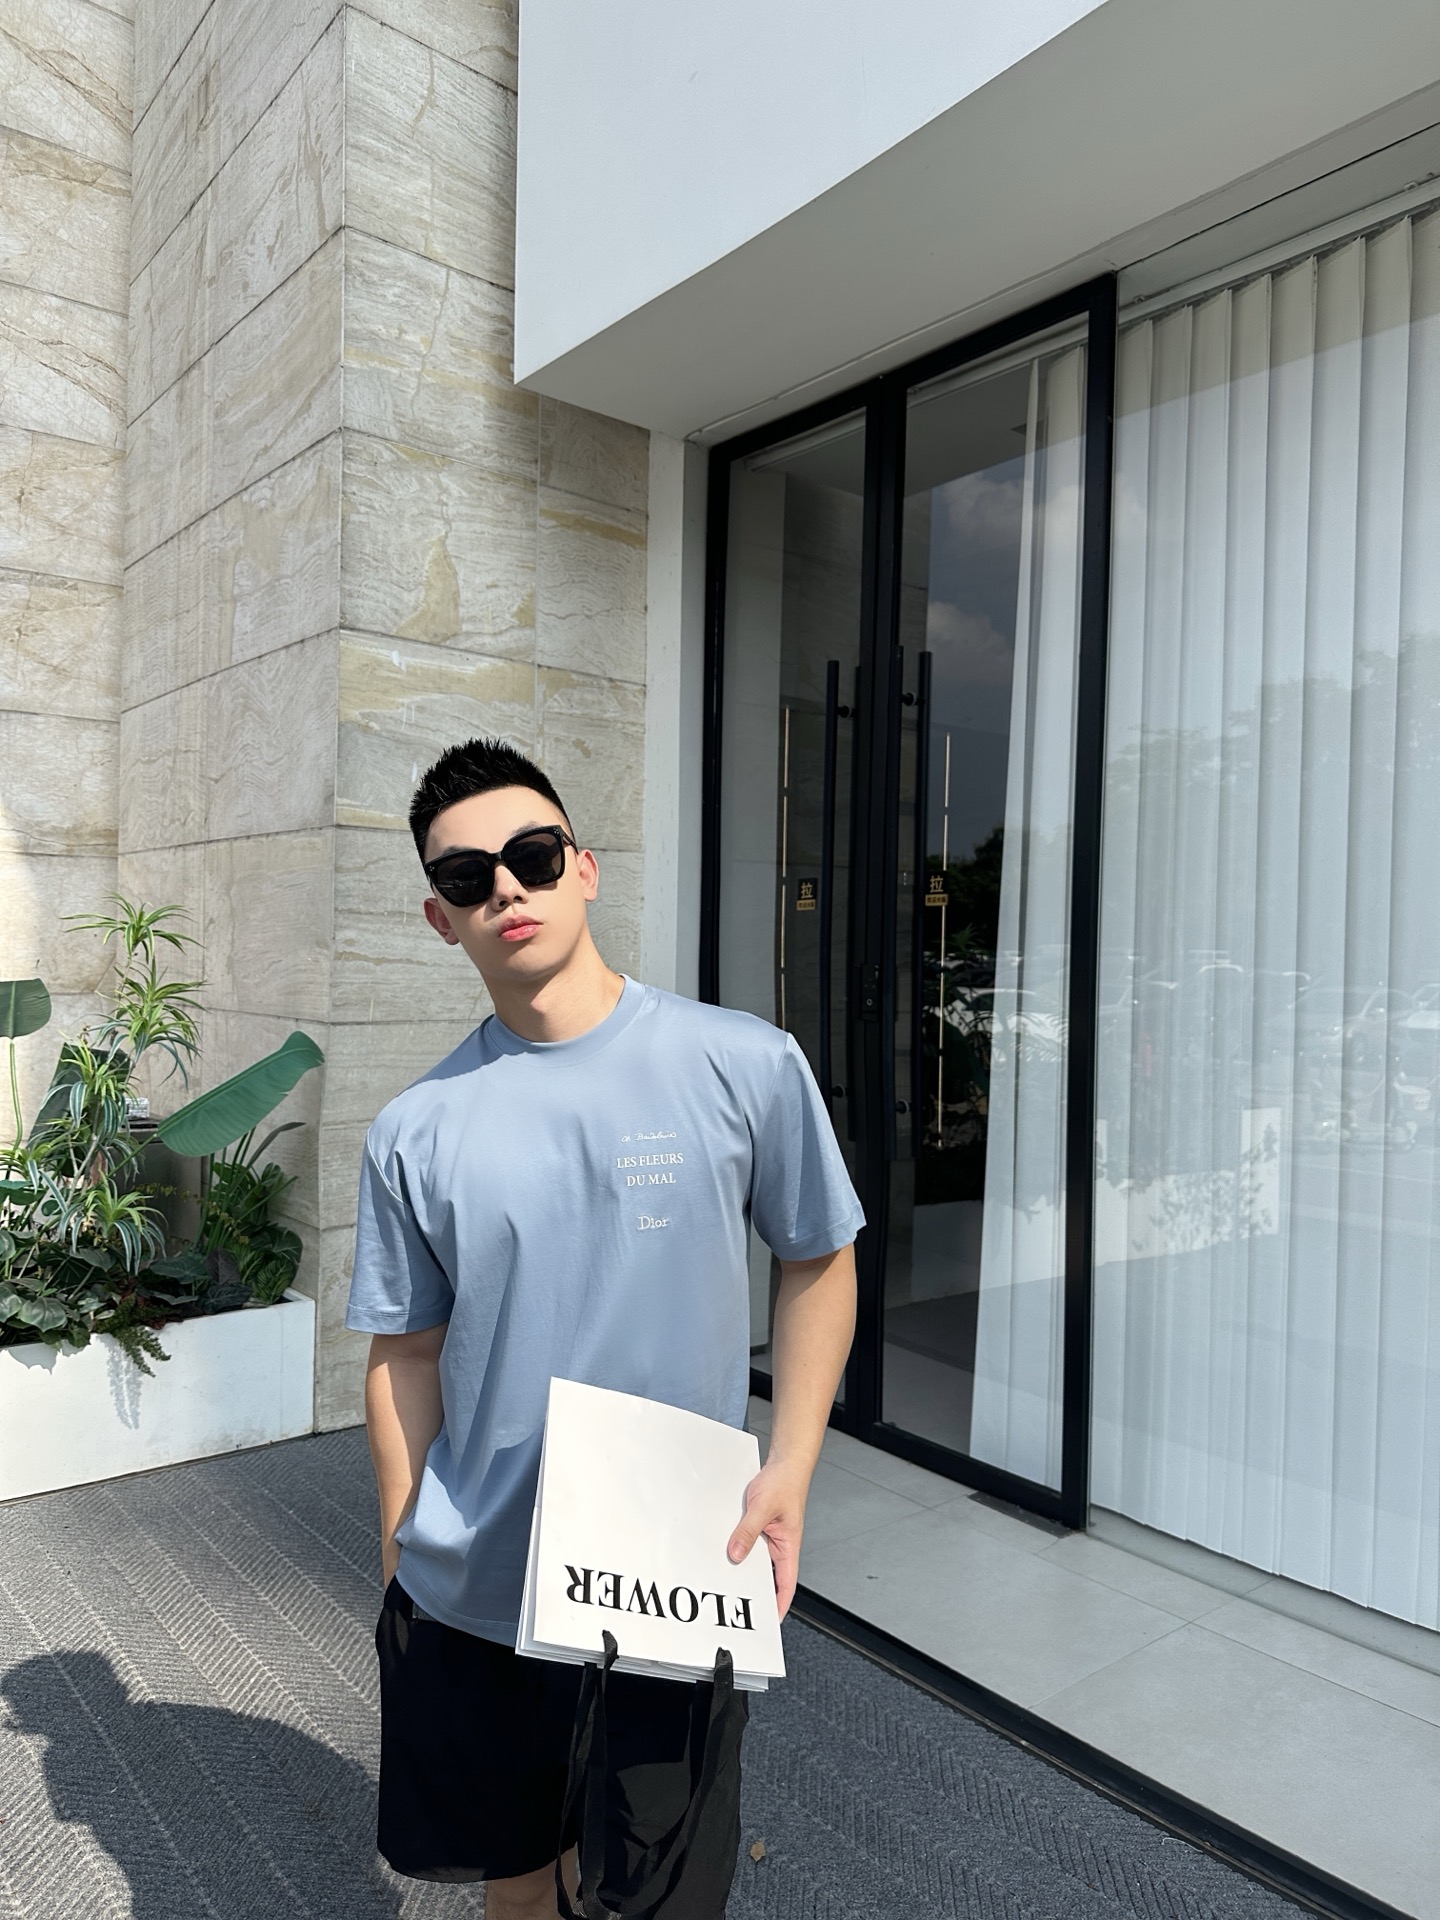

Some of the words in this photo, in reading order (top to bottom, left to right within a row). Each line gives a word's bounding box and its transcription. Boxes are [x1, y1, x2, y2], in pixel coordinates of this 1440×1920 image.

[800, 882, 813, 899] 拉
[929, 875, 944, 893] 拉
[617, 1157, 637, 1168] LES
[639, 1153, 683, 1166] FLEURS
[627, 1175, 645, 1186] DU
[648, 1172, 676, 1185] MAL
[637, 1215, 670, 1231] Dior
[564, 1564, 756, 1631] FLOWER
